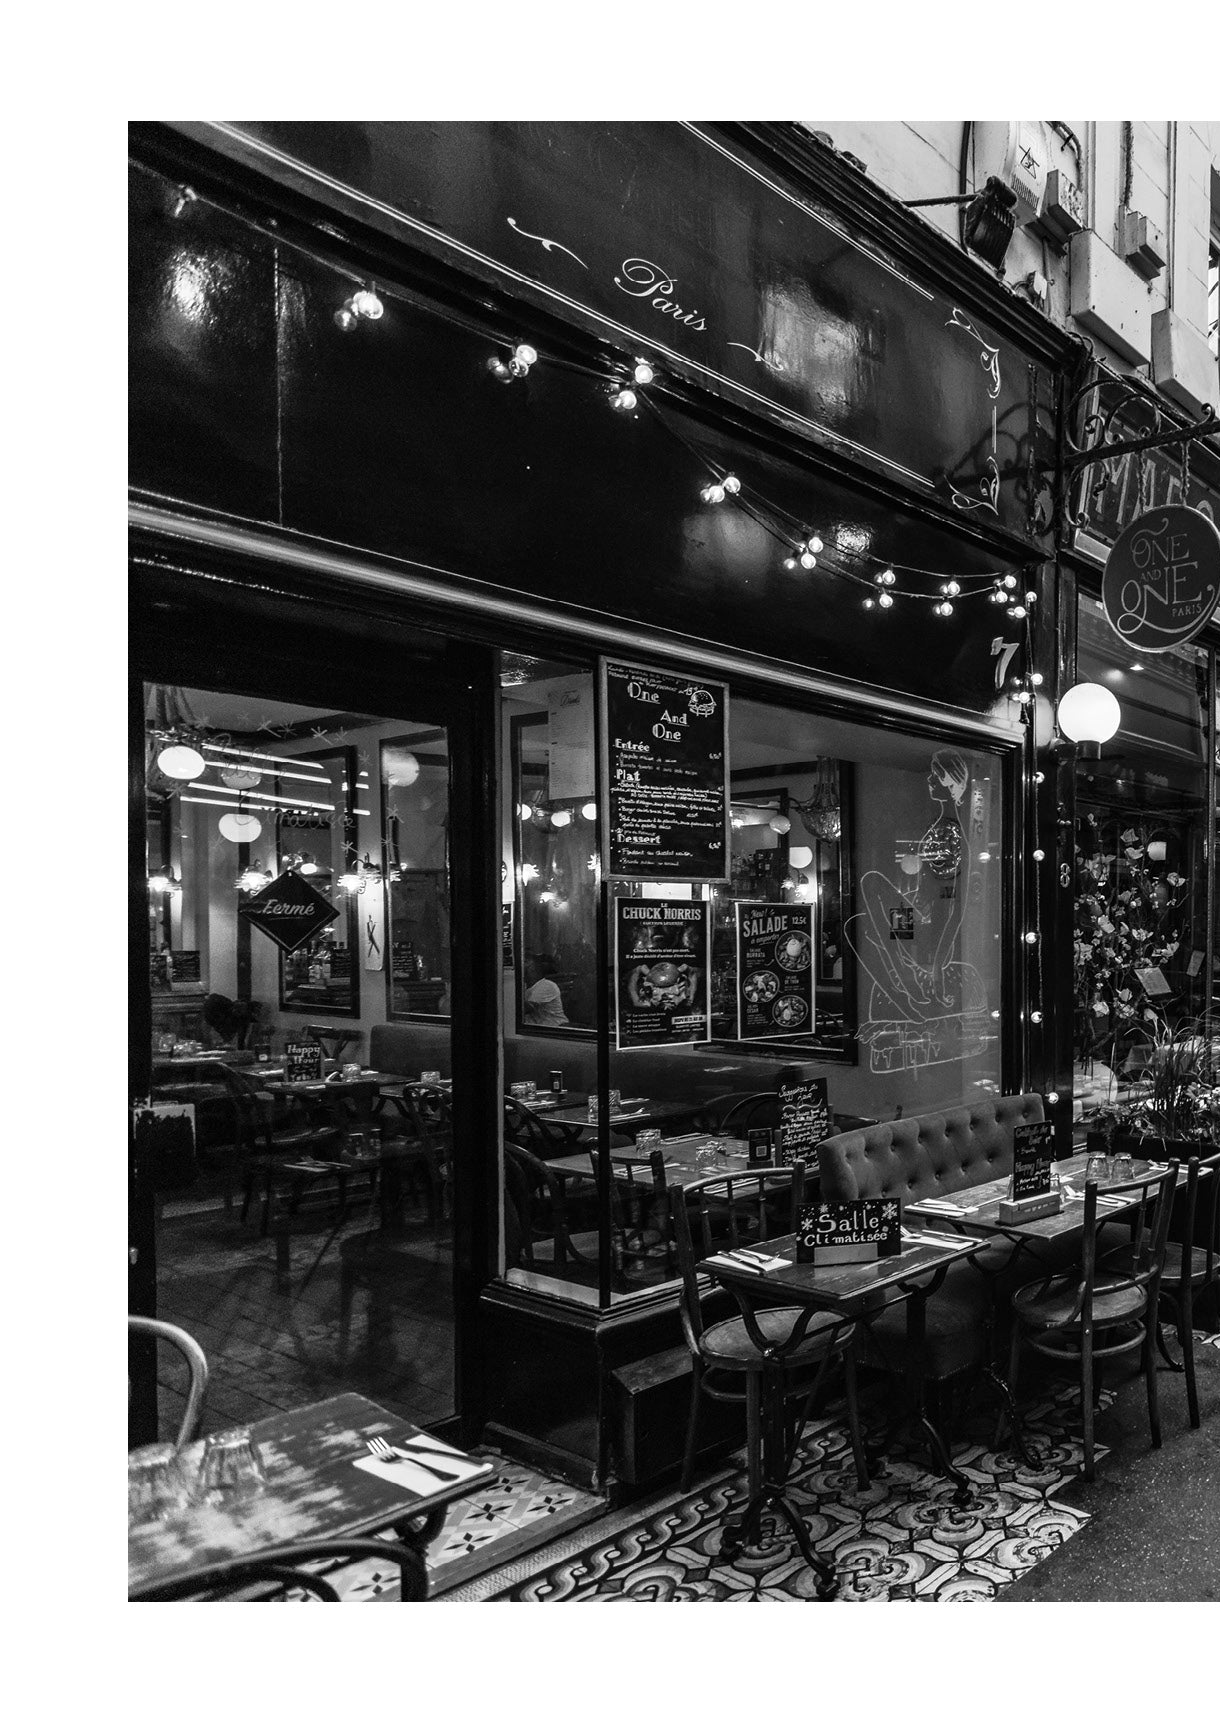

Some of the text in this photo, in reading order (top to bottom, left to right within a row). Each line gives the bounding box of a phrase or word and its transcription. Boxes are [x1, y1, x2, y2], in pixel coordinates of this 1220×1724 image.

[614, 258, 707, 331] Paris
[1131, 518, 1189, 568] ONE
[1140, 569, 1162, 582] AND
[1117, 561, 1205, 634] ONE
[1171, 603, 1203, 617] PARIS
[990, 637, 1020, 688] 7
[627, 682, 660, 702] One
[660, 709, 688, 725] And
[652, 723, 682, 740] One
[615, 738, 650, 752] Entrée
[616, 768, 641, 781] Plat
[617, 834, 661, 844] Dessert
[1060, 862, 1070, 888] 8
[262, 899, 315, 916] Fermé
[622, 906, 702, 921] CHUCK NORRIS
[743, 915, 788, 938] SALADE
[287, 1044, 321, 1058] Happy
[816, 1209, 879, 1233] Salle
[804, 1229, 888, 1247] Climatisée
